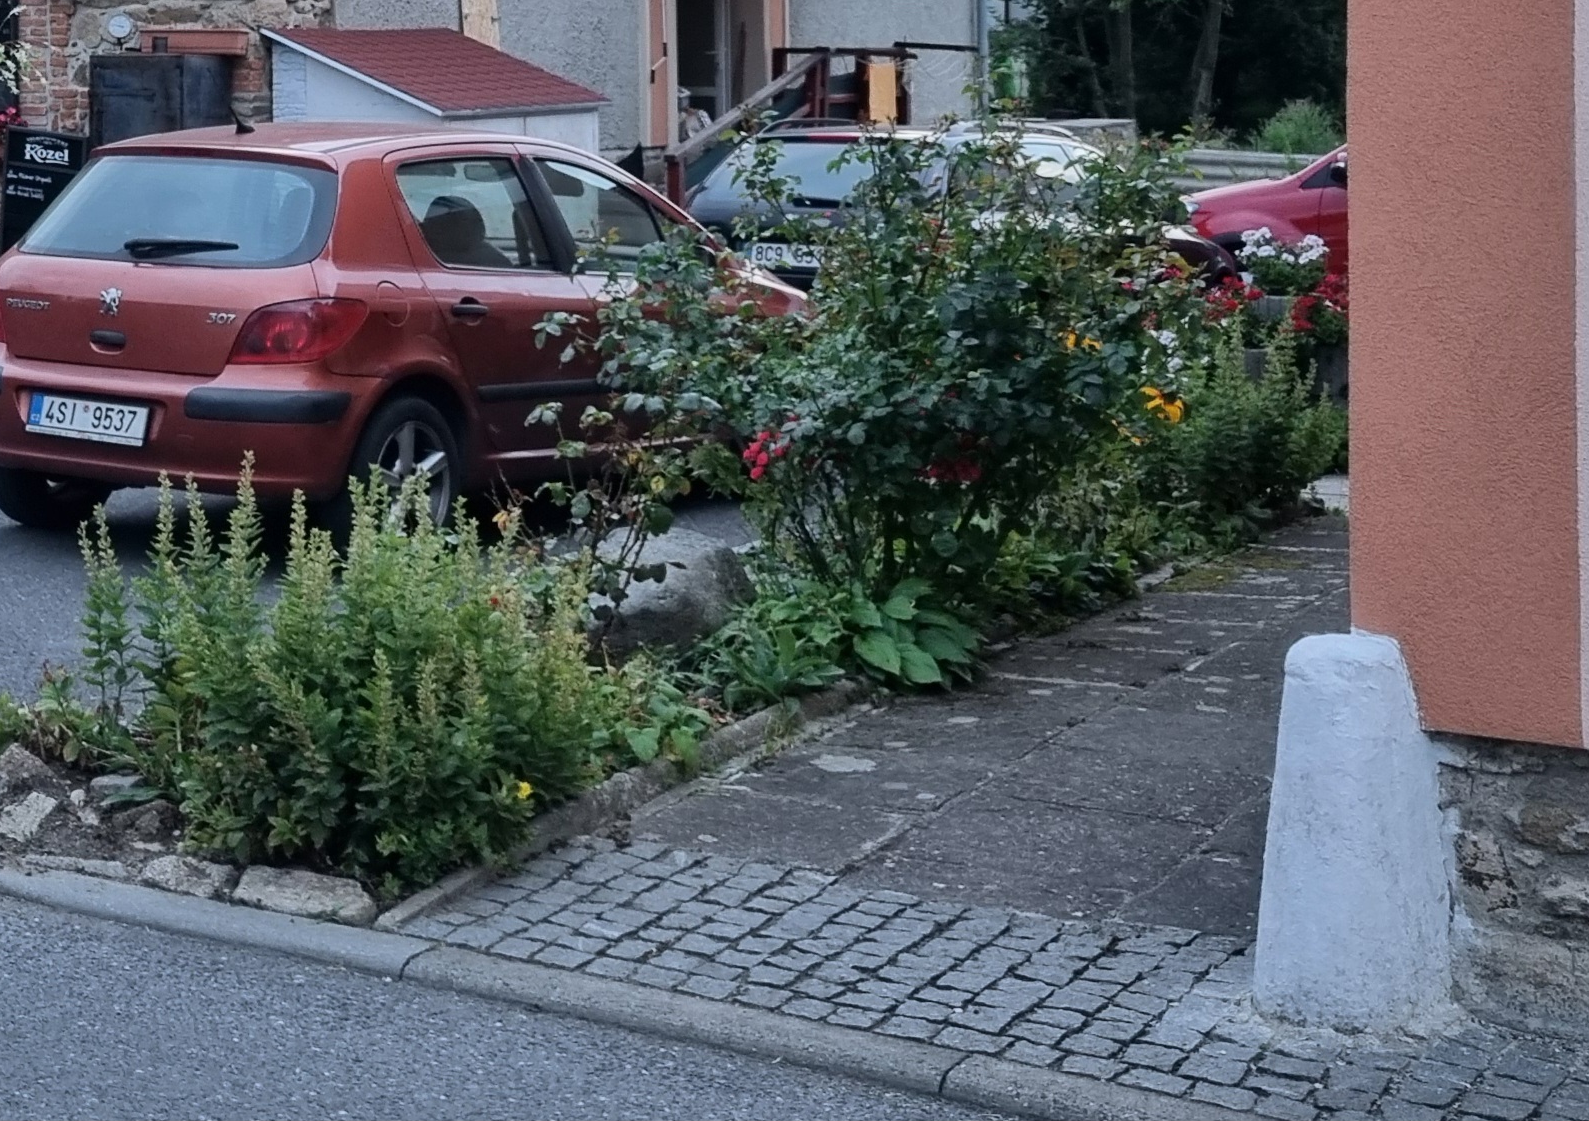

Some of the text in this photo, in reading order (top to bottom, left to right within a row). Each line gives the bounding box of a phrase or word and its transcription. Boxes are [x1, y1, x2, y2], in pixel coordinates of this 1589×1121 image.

[24, 143, 70, 165] Kozel
[755, 245, 783, 262] 8C9
[206, 312, 236, 324] 307
[91, 405, 138, 433] 9537
